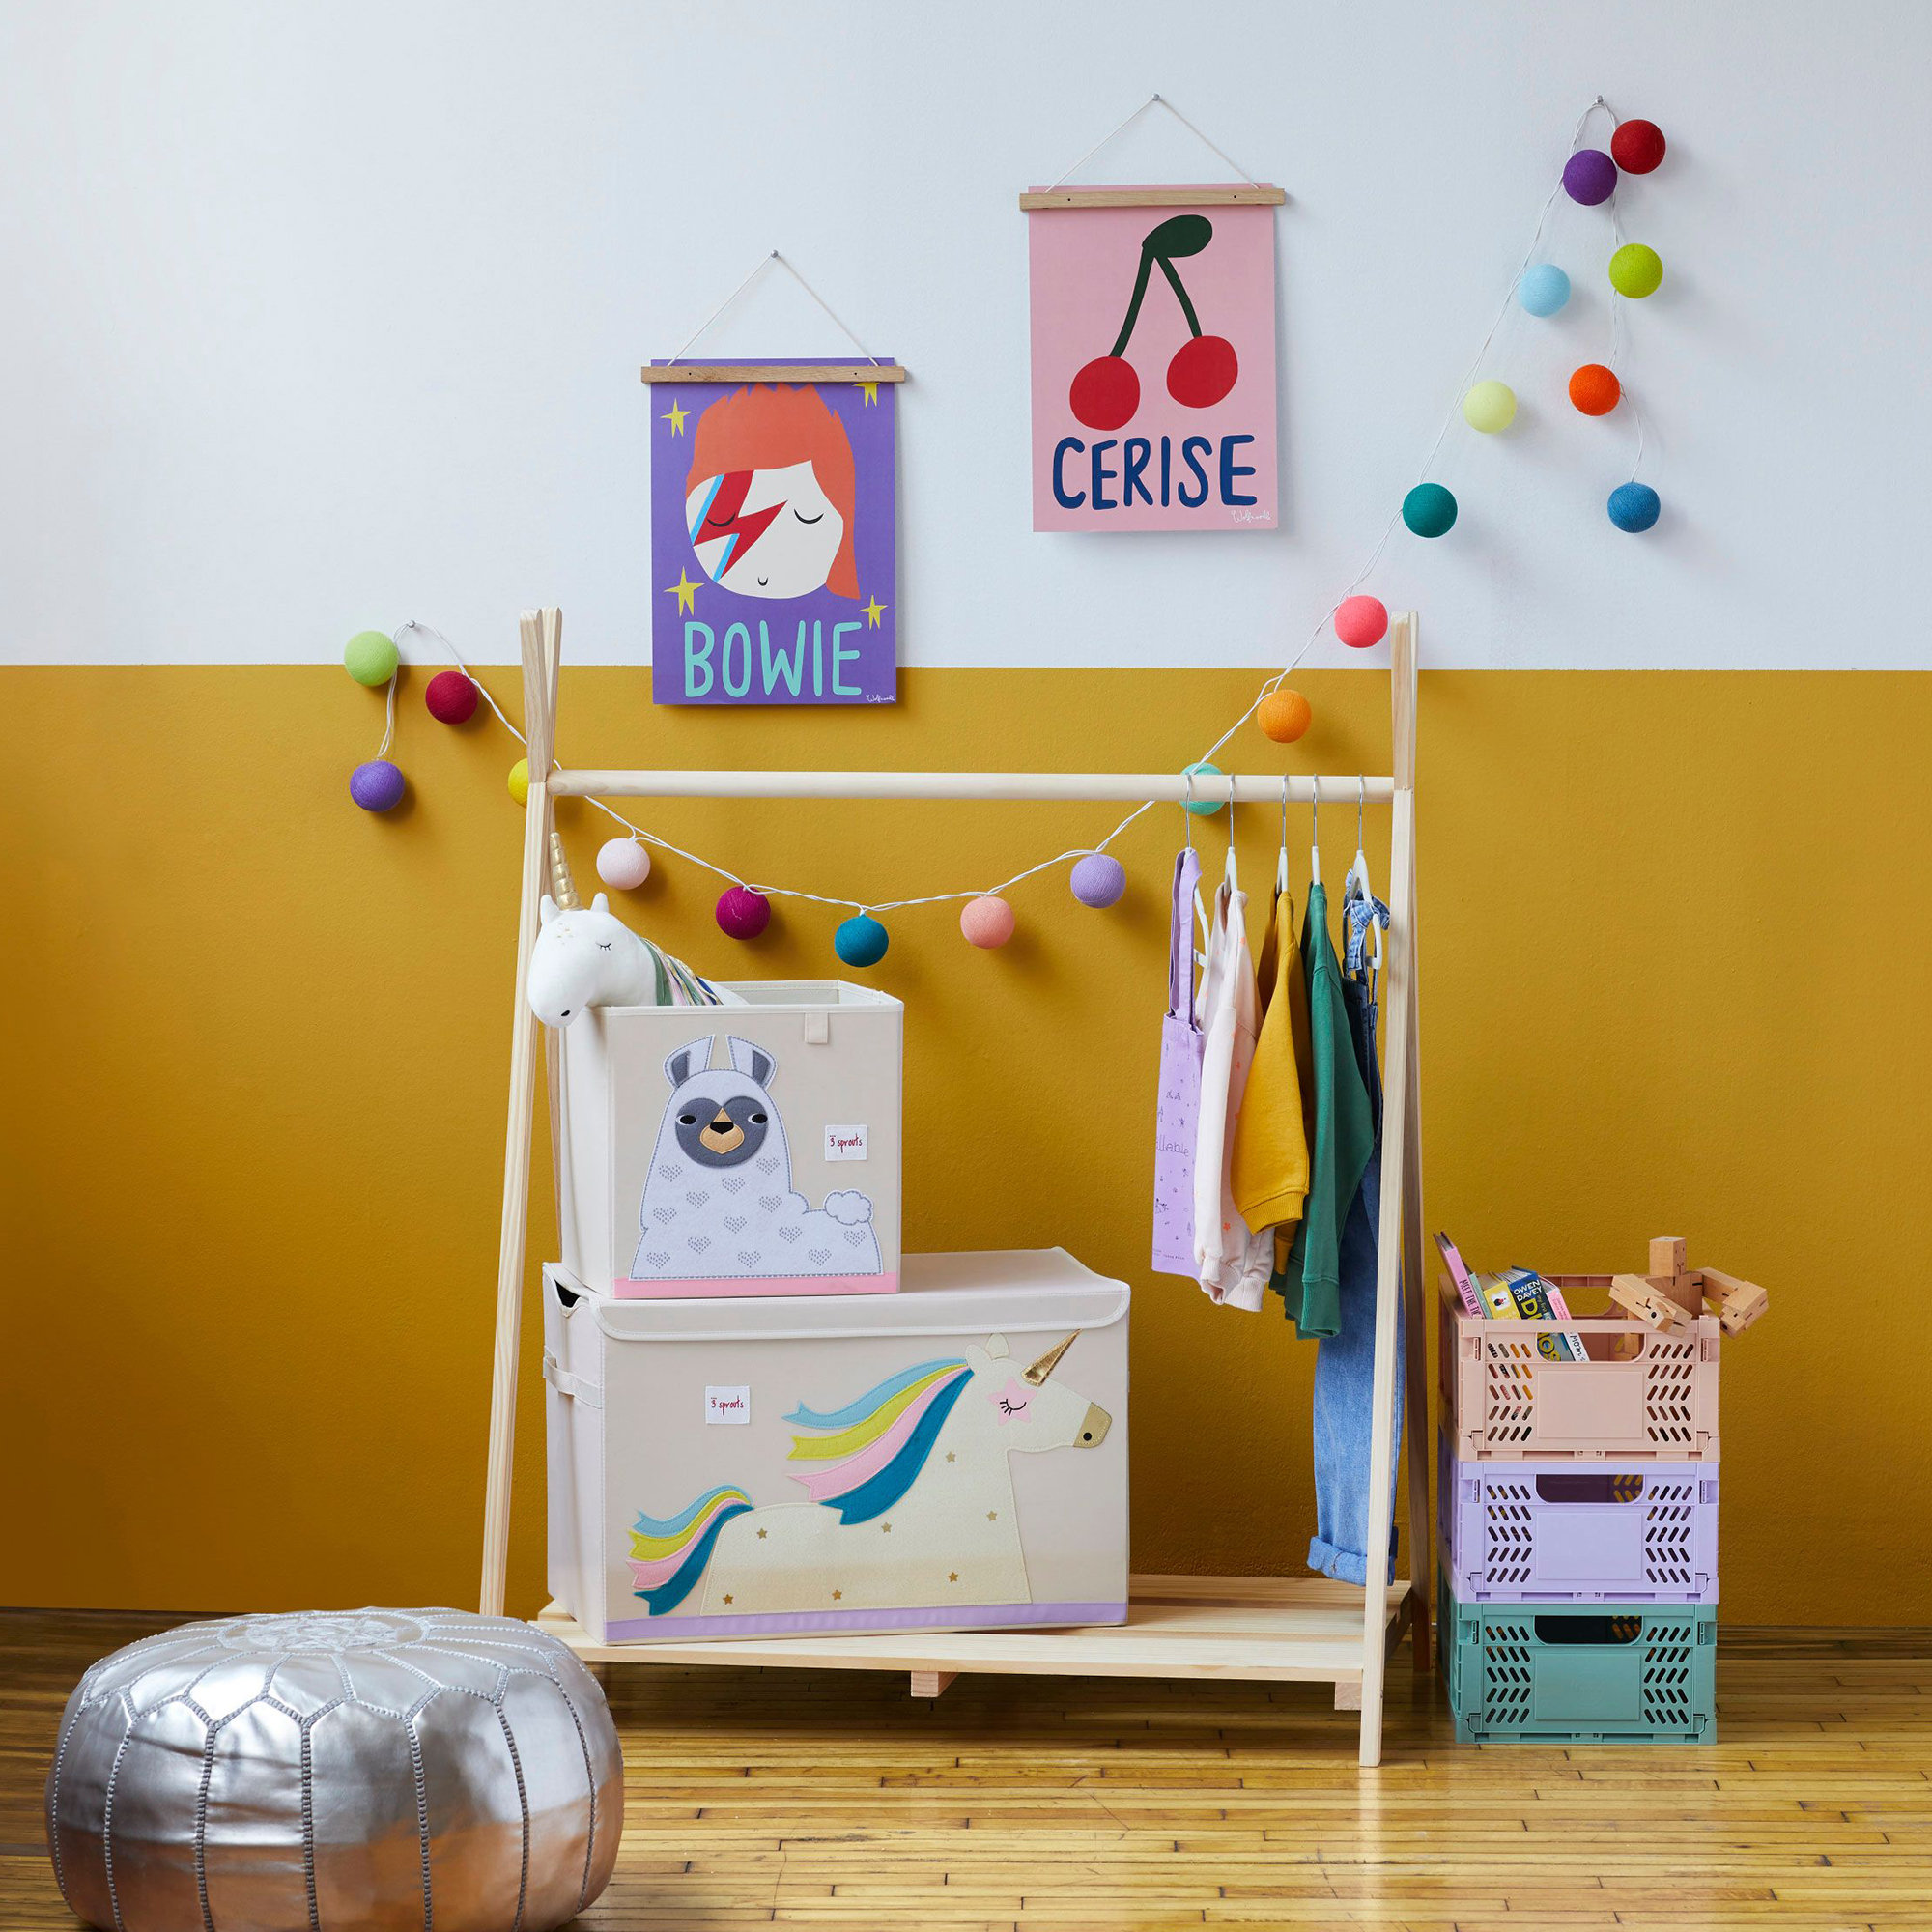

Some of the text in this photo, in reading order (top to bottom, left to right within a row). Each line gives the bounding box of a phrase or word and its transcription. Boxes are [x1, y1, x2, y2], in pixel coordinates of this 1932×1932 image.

[1053, 435, 1257, 510] CERISE
[684, 620, 862, 697] BOWIE
[838, 1133, 863, 1153] sprouts
[1459, 1279, 1473, 1295] MEET
[1513, 1279, 1541, 1295] OWEN
[1517, 1286, 1543, 1302] DAVEY
[1465, 1294, 1477, 1307] THE
[711, 1395, 744, 1416] 3 sprouts
